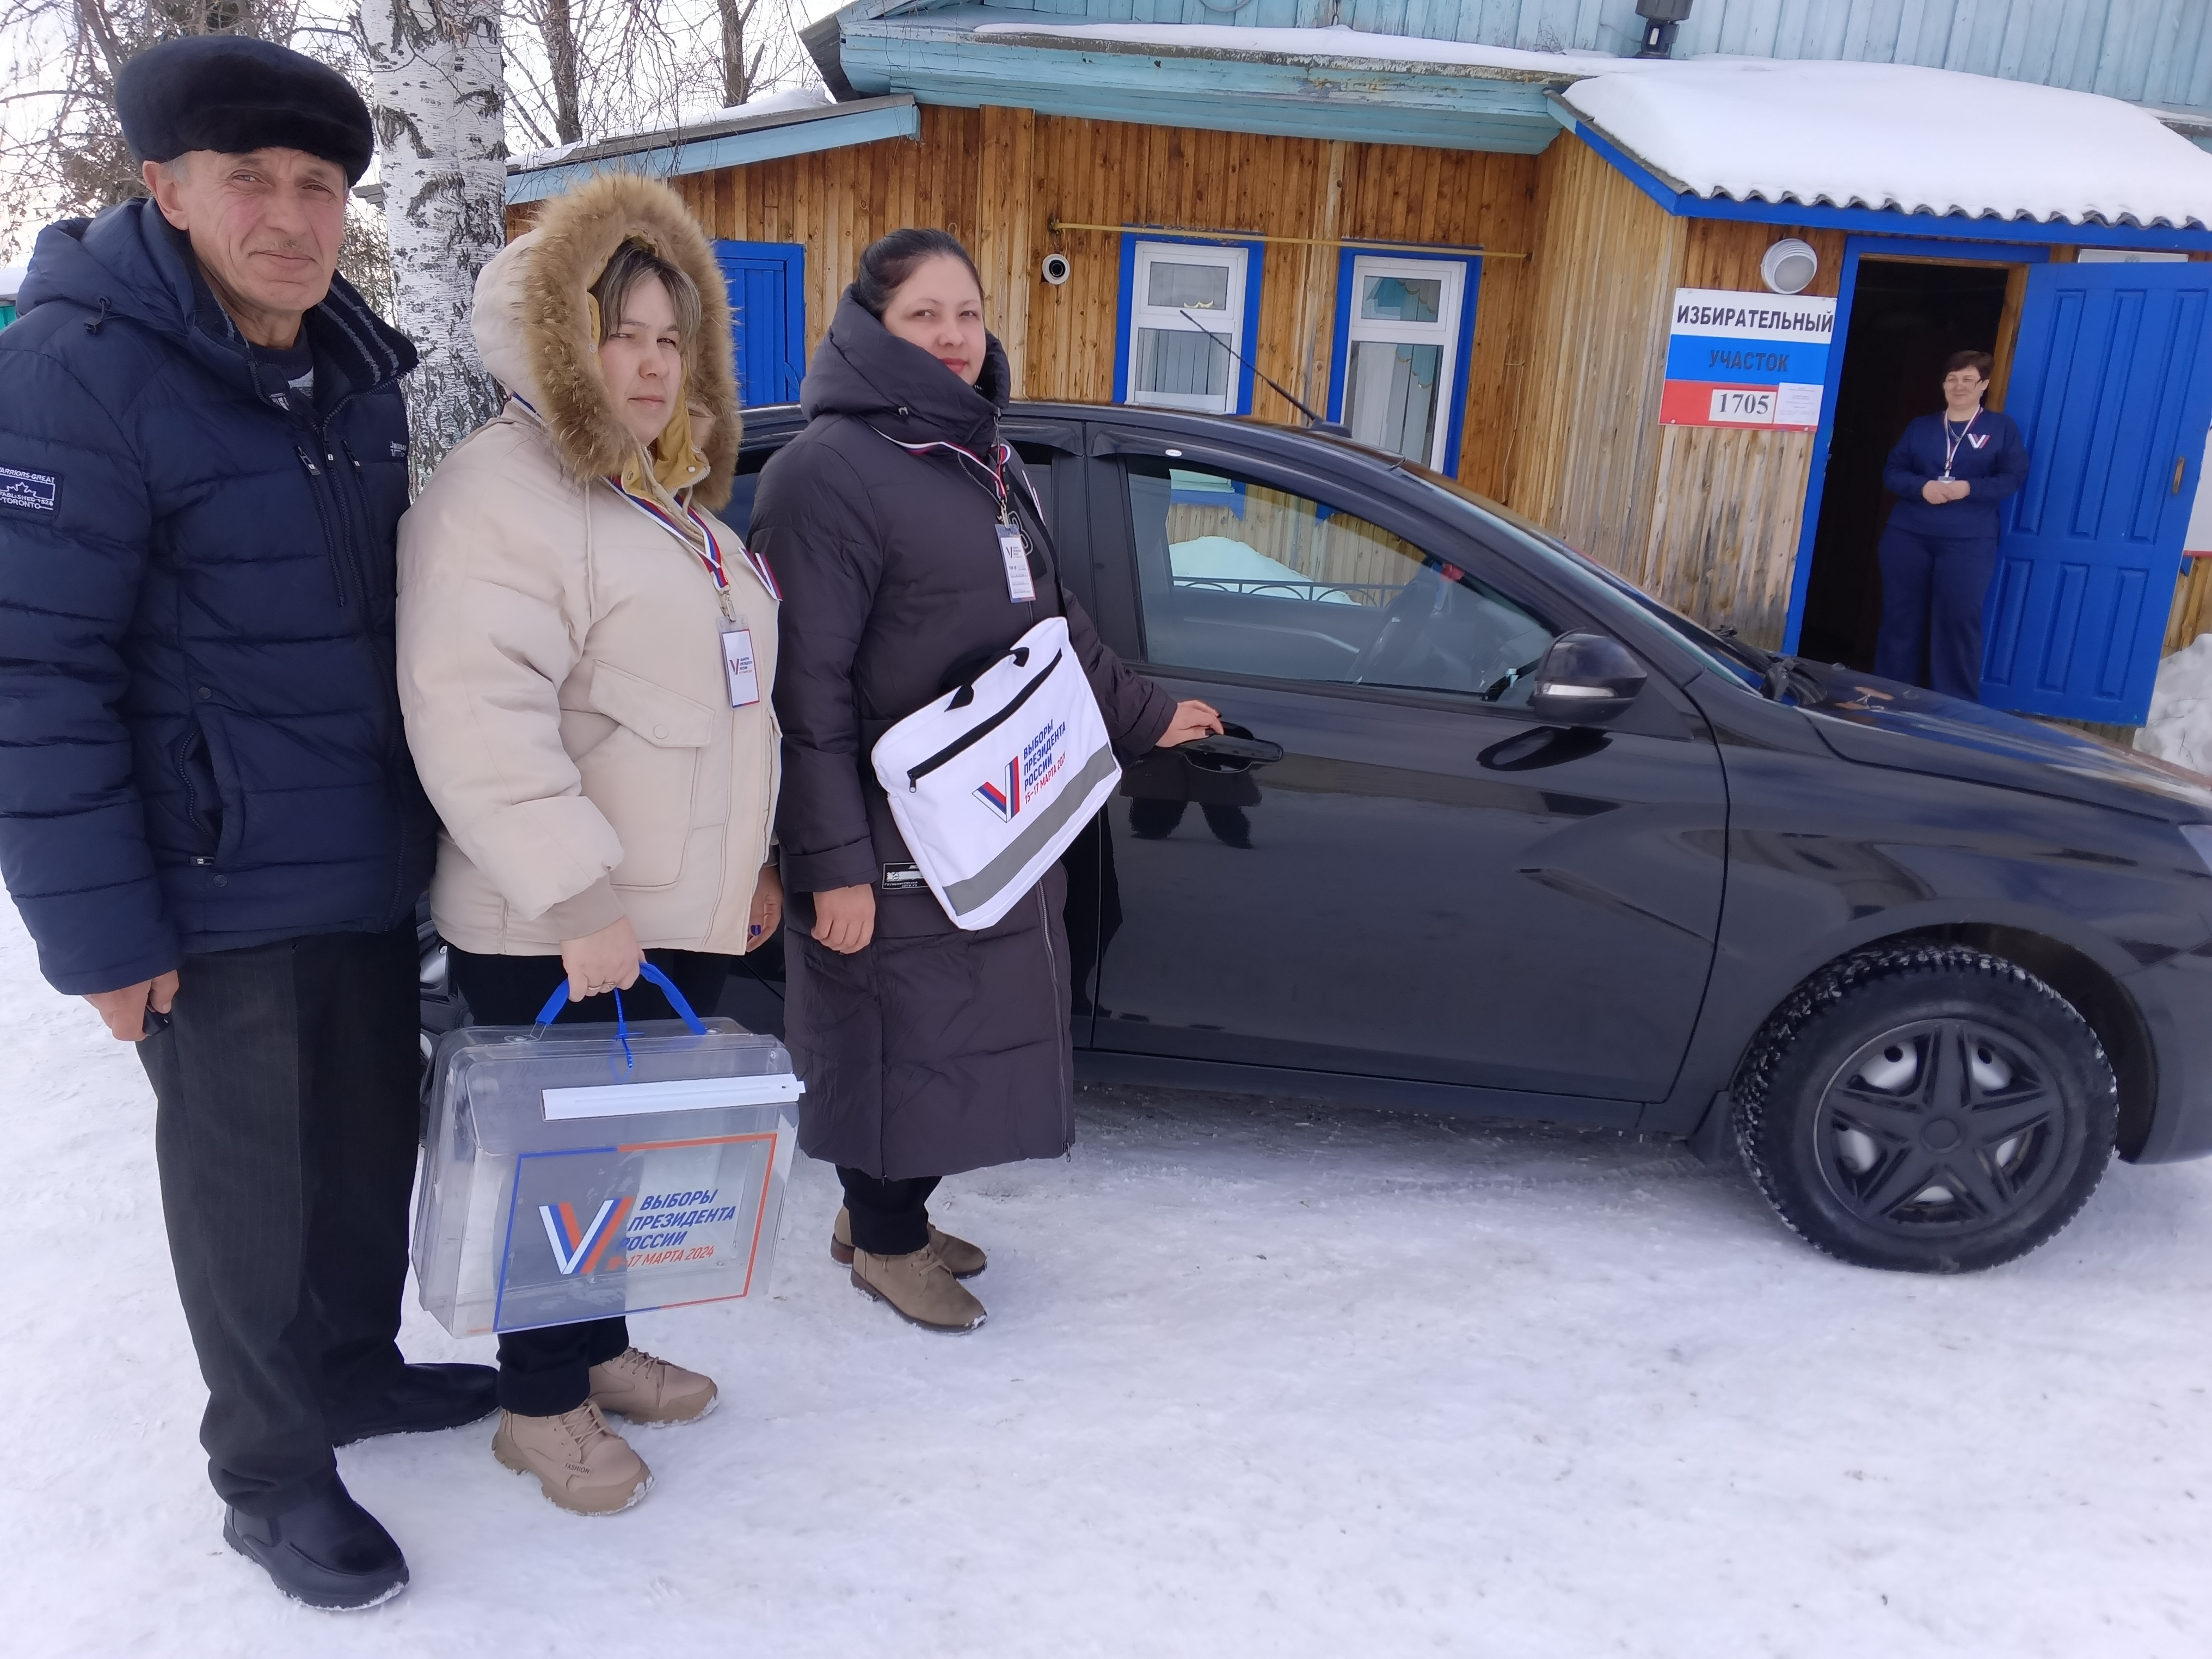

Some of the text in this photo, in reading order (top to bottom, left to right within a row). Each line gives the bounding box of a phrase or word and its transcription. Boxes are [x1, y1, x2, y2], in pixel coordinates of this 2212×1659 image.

[1677, 304, 1834, 333] ИЗБИРАТЕЛЬНЫЙ
[1708, 349, 1790, 372] УЧАСТОК
[1719, 392, 1770, 415] 1705
[1023, 719, 1053, 760] ВЫБОРЫ
[1024, 721, 1066, 776] ПРЕЗИДЕНТА
[1024, 753, 1052, 791] РОССИИ
[1040, 764, 1056, 789] МАРТА
[640, 1189, 719, 1211] ВЫБОРЫ
[626, 1206, 736, 1232] ПРЕЗИДЕНТА
[616, 1231, 689, 1252] РОССИИ
[641, 1249, 685, 1267] МАРТА
[684, 1245, 715, 1261] 2024
[564, 1463, 590, 1474] FASHION
